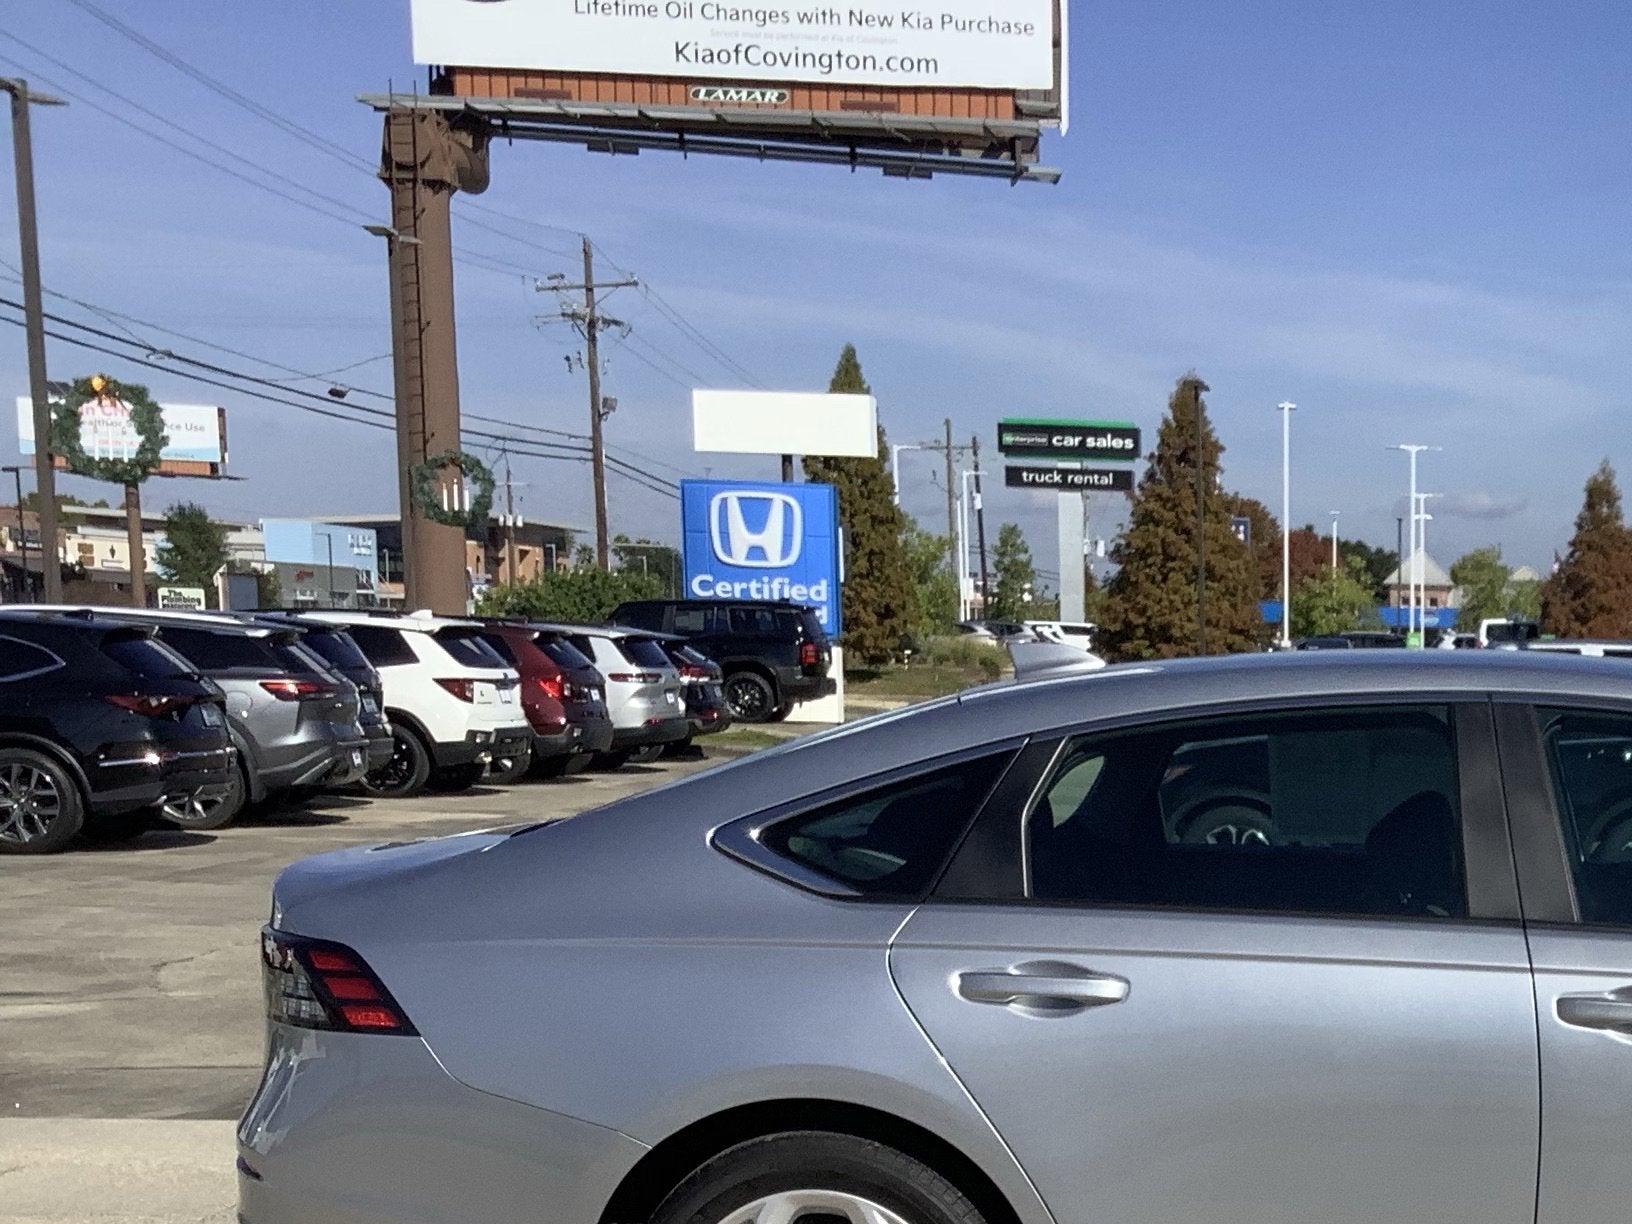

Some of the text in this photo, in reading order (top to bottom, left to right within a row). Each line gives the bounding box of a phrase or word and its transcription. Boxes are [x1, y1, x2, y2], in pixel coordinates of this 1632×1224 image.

[574, 0, 1035, 36] Lifetime Oil Changes with New Kia Purchase
[674, 41, 939, 74] KiaofCovington.com
[698, 87, 779, 103] LAMAR
[185, 423, 205, 432] Use
[1051, 434, 1083, 447] car
[1085, 433, 1135, 450] sales
[1021, 470, 1114, 485] truck rental
[167, 589, 183, 597] The
[691, 574, 828, 600] Certified
[161, 595, 202, 606] Plumbing
